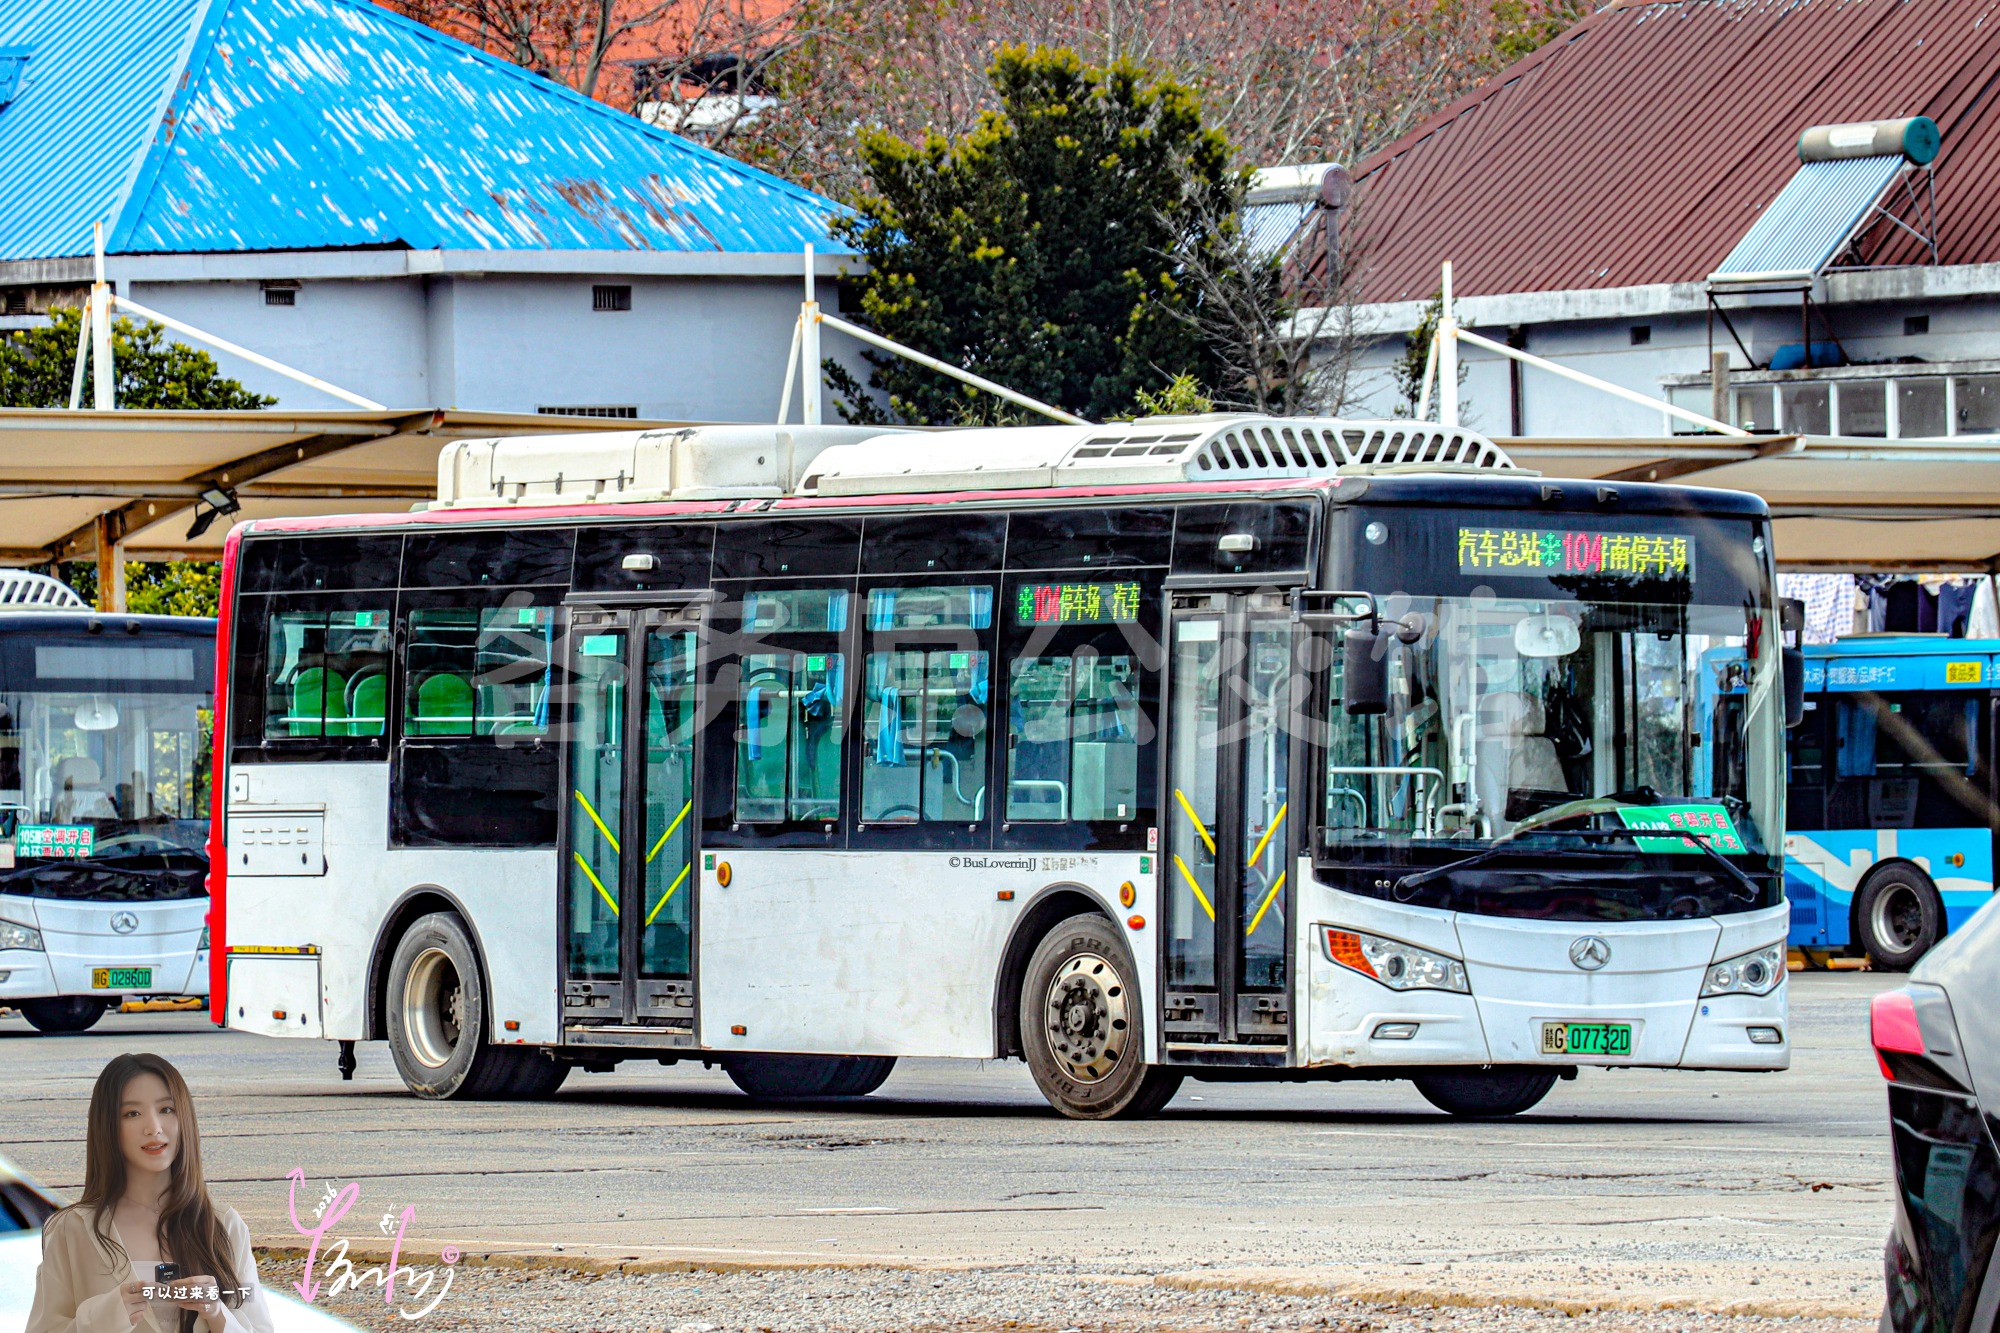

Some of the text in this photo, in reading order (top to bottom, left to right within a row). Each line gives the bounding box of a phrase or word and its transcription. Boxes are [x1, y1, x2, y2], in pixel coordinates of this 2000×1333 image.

[1458, 529, 1686, 574] 汽车总站 104 南停车场
[1033, 582, 1141, 622] 104 停车场 汽车
[111, 970, 151, 986] 02860D
[1571, 1027, 1629, 1051] 07732D
